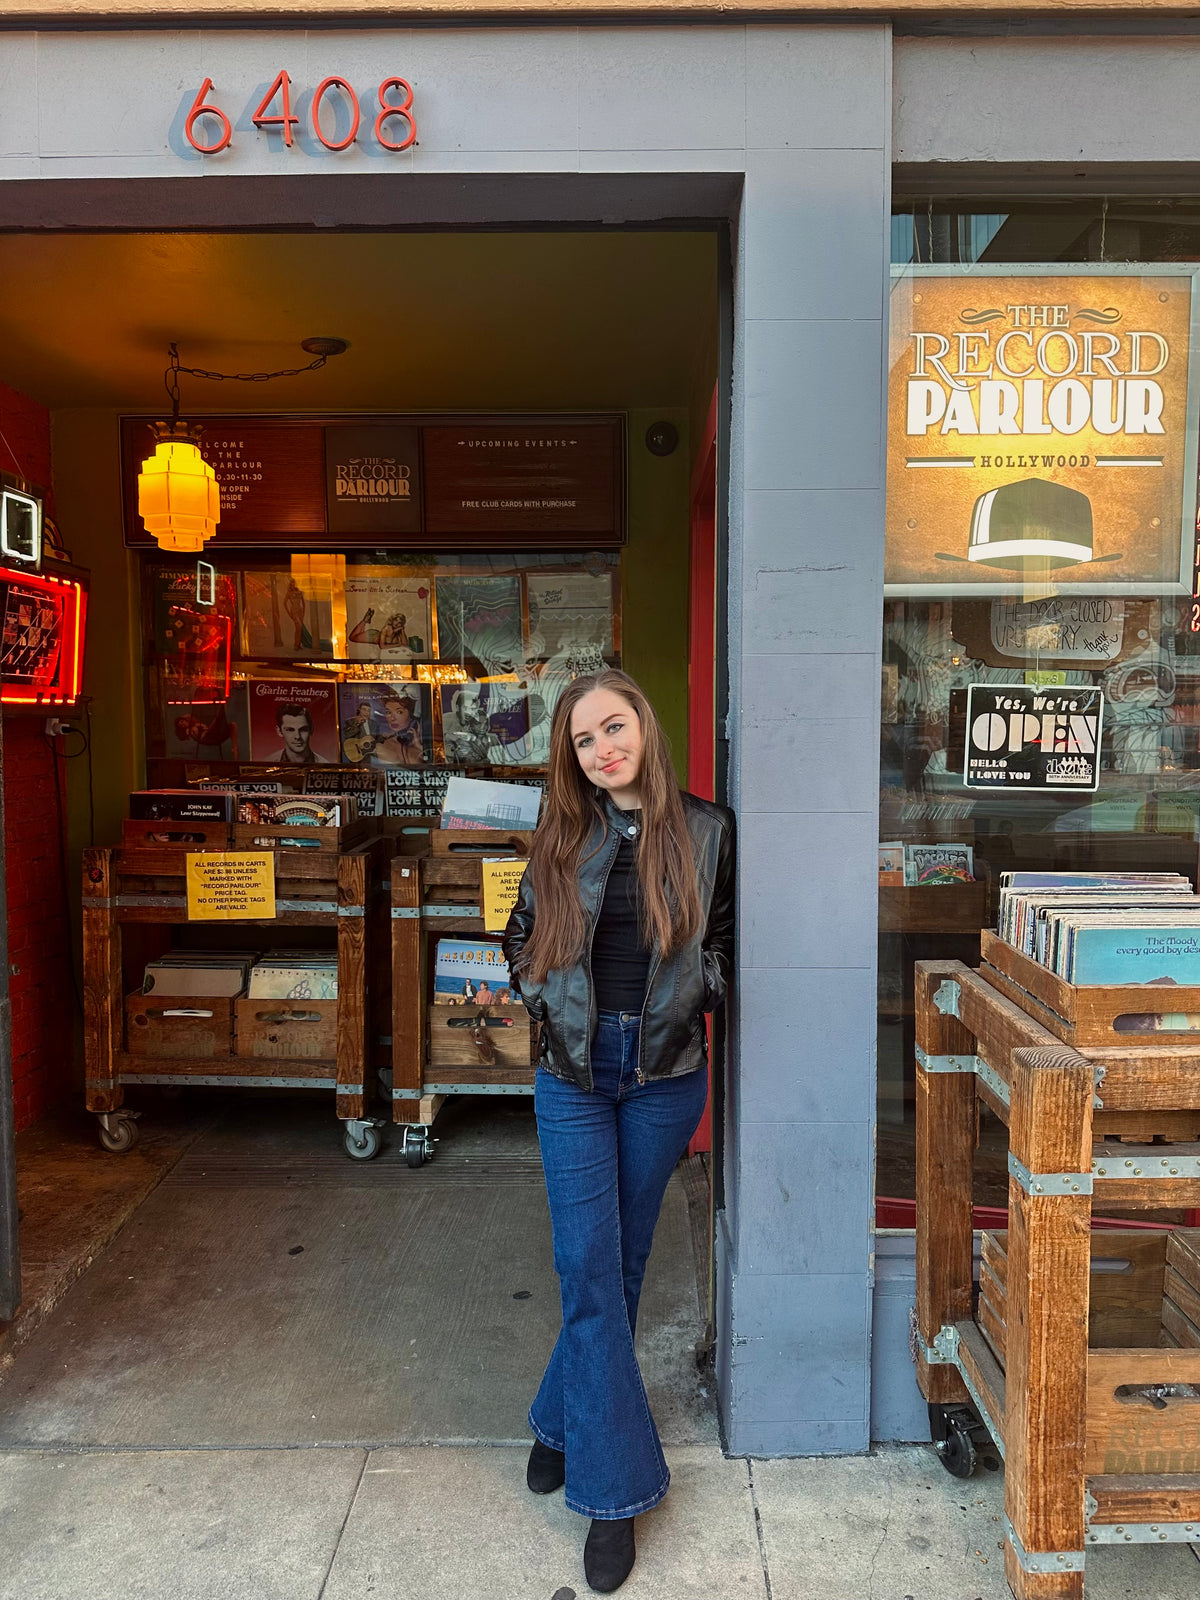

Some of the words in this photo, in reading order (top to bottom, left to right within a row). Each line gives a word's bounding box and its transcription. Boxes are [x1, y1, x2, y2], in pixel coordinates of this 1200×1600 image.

[185, 70, 417, 153] 6408
[1007, 305, 1069, 328] THE
[909, 330, 1169, 389] RECORD
[907, 379, 1165, 435] PARLOUR
[980, 455, 1090, 468] HOLLYWOOD
[336, 465, 410, 480] RECORD
[336, 479, 410, 496] PARLOUR
[995, 603, 1021, 622] THE
[1070, 599, 1112, 623] CLOSED
[1083, 630, 1110, 652] thank
[256, 684, 289, 697] Charlie
[290, 685, 329, 698] Feathers
[994, 696, 1026, 712] Yes,
[1033, 696, 1078, 711] We're
[972, 713, 1097, 753] OPEN
[970, 759, 1008, 768] HELLO
[387, 770, 420, 778] HONK
[424, 770, 435, 778] IF
[970, 770, 974, 778] I
[977, 771, 1006, 780] LOVE
[1009, 772, 1031, 780] YOU
[252, 784, 276, 792] YOU
[307, 780, 340, 788] LOVE
[342, 780, 376, 789] VINYL
[388, 777, 420, 787] LOVE
[424, 777, 450, 786] VINY
[388, 789, 421, 797] HONK
[388, 796, 421, 805] LOVE
[390, 808, 422, 817] HONK
[1145, 937, 1164, 945] The
[1166, 937, 1199, 946] Moody
[441, 950, 506, 964] INSIDERS
[1116, 948, 1141, 956] every
[1143, 946, 1165, 955] good
[1166, 946, 1182, 955] boy
